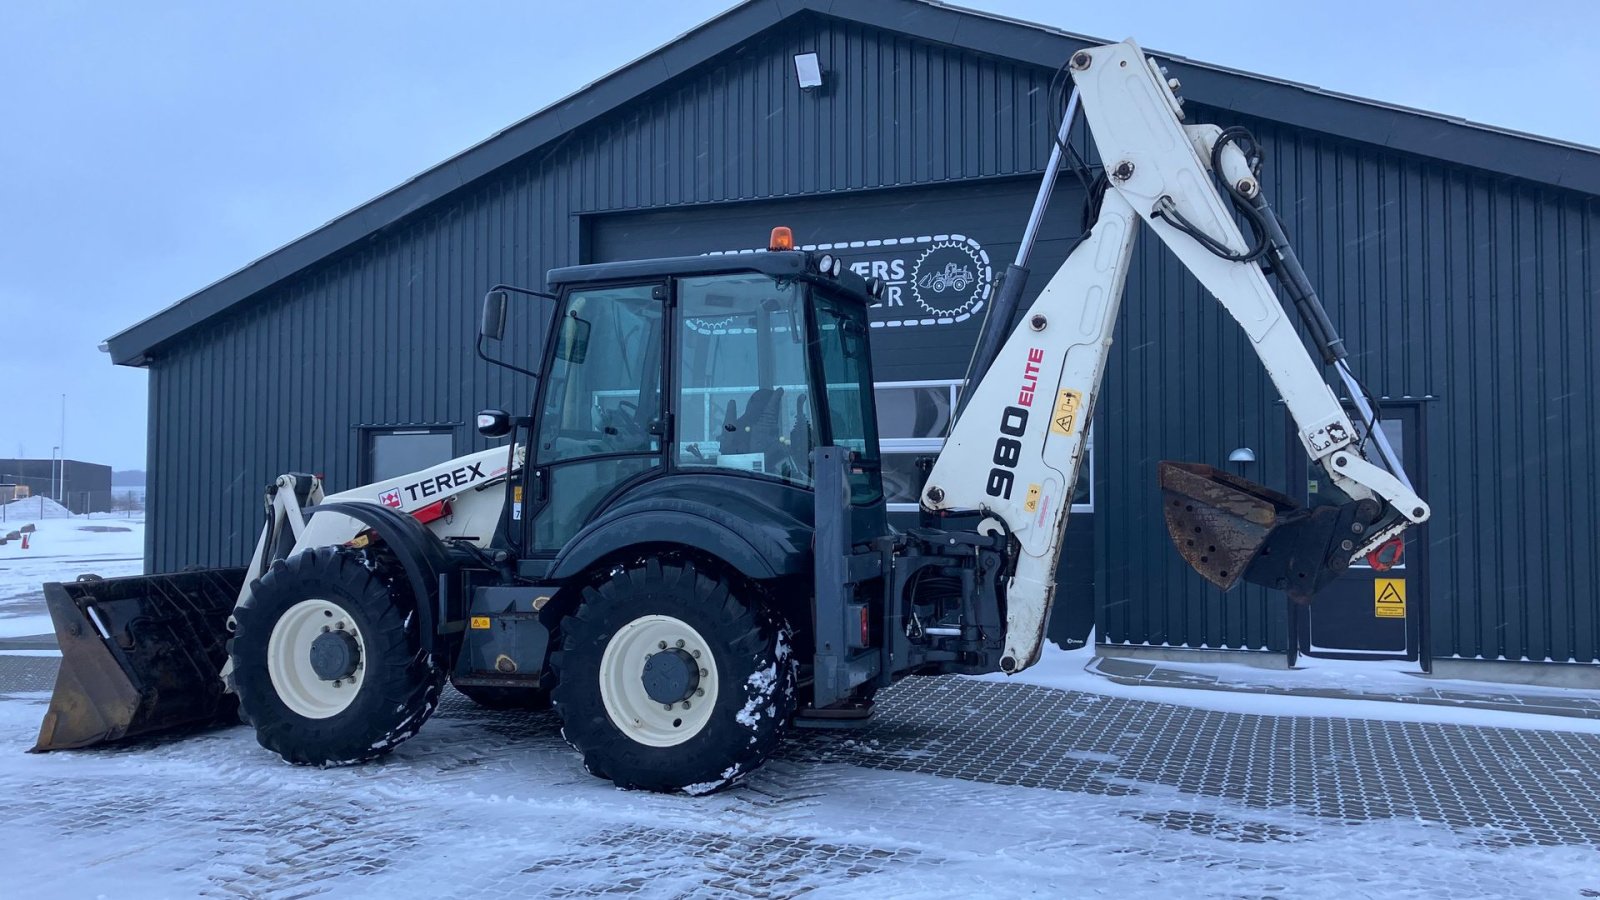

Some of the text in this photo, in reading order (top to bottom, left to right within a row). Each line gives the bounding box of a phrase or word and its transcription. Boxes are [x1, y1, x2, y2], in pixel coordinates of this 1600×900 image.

[986, 347, 1044, 500] 980 ELITE
[404, 461, 486, 501] TEREX
